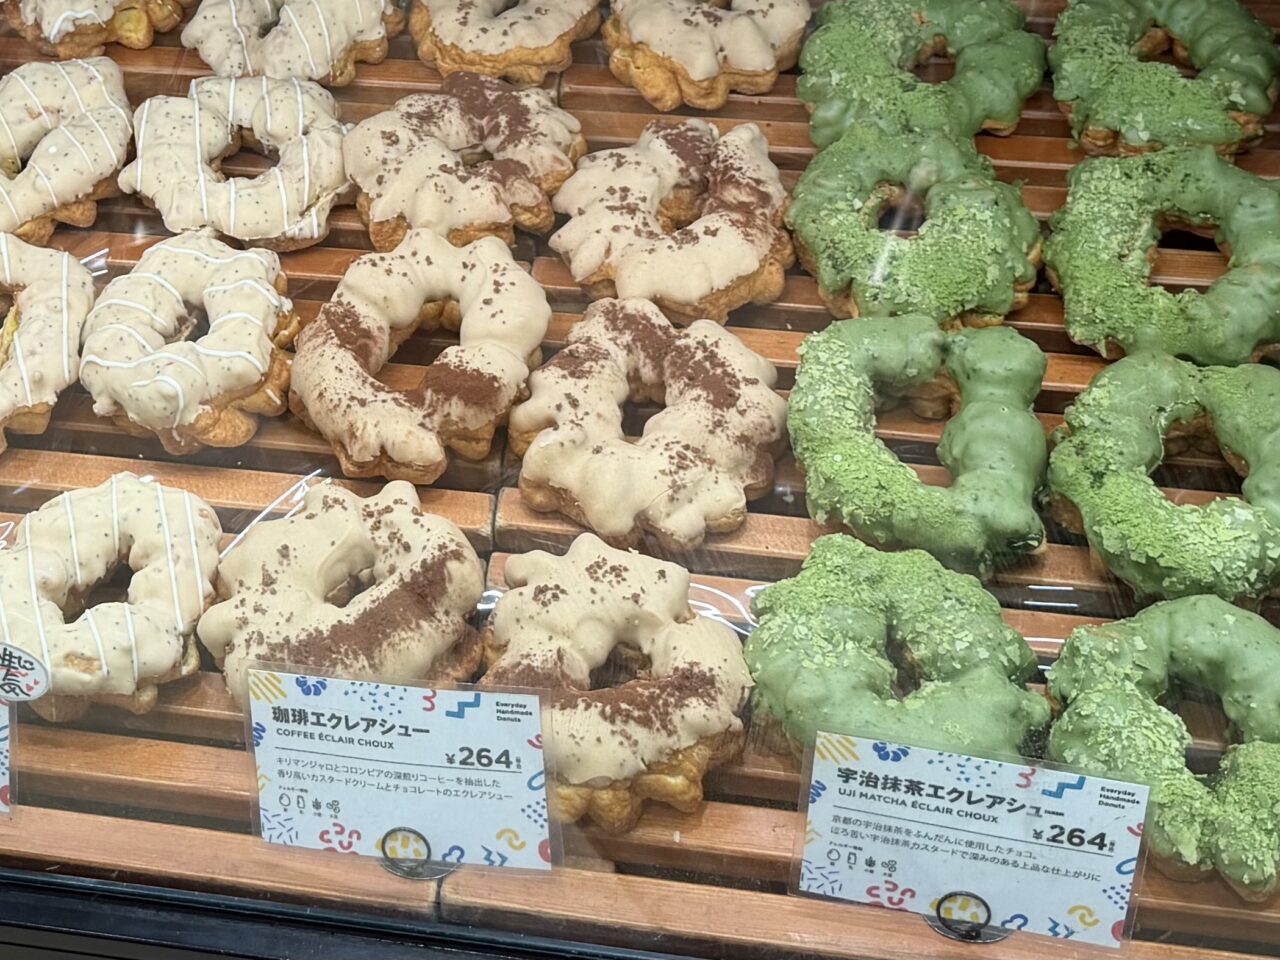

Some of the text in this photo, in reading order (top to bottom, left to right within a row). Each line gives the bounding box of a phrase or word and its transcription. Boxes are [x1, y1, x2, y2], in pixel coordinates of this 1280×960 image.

[271, 706, 431, 738] 珈琲エクレアシュー
[276, 727, 395, 750] COFFEE ÉCLAIR CHOUX
[445, 746, 513, 770] ¥264
[837, 767, 1065, 818] 宇治抹茶エクレアシュー
[838, 787, 999, 825] UJI MATCHA ÉCLAIR CHOUX
[1032, 824, 1108, 851] ¥264
